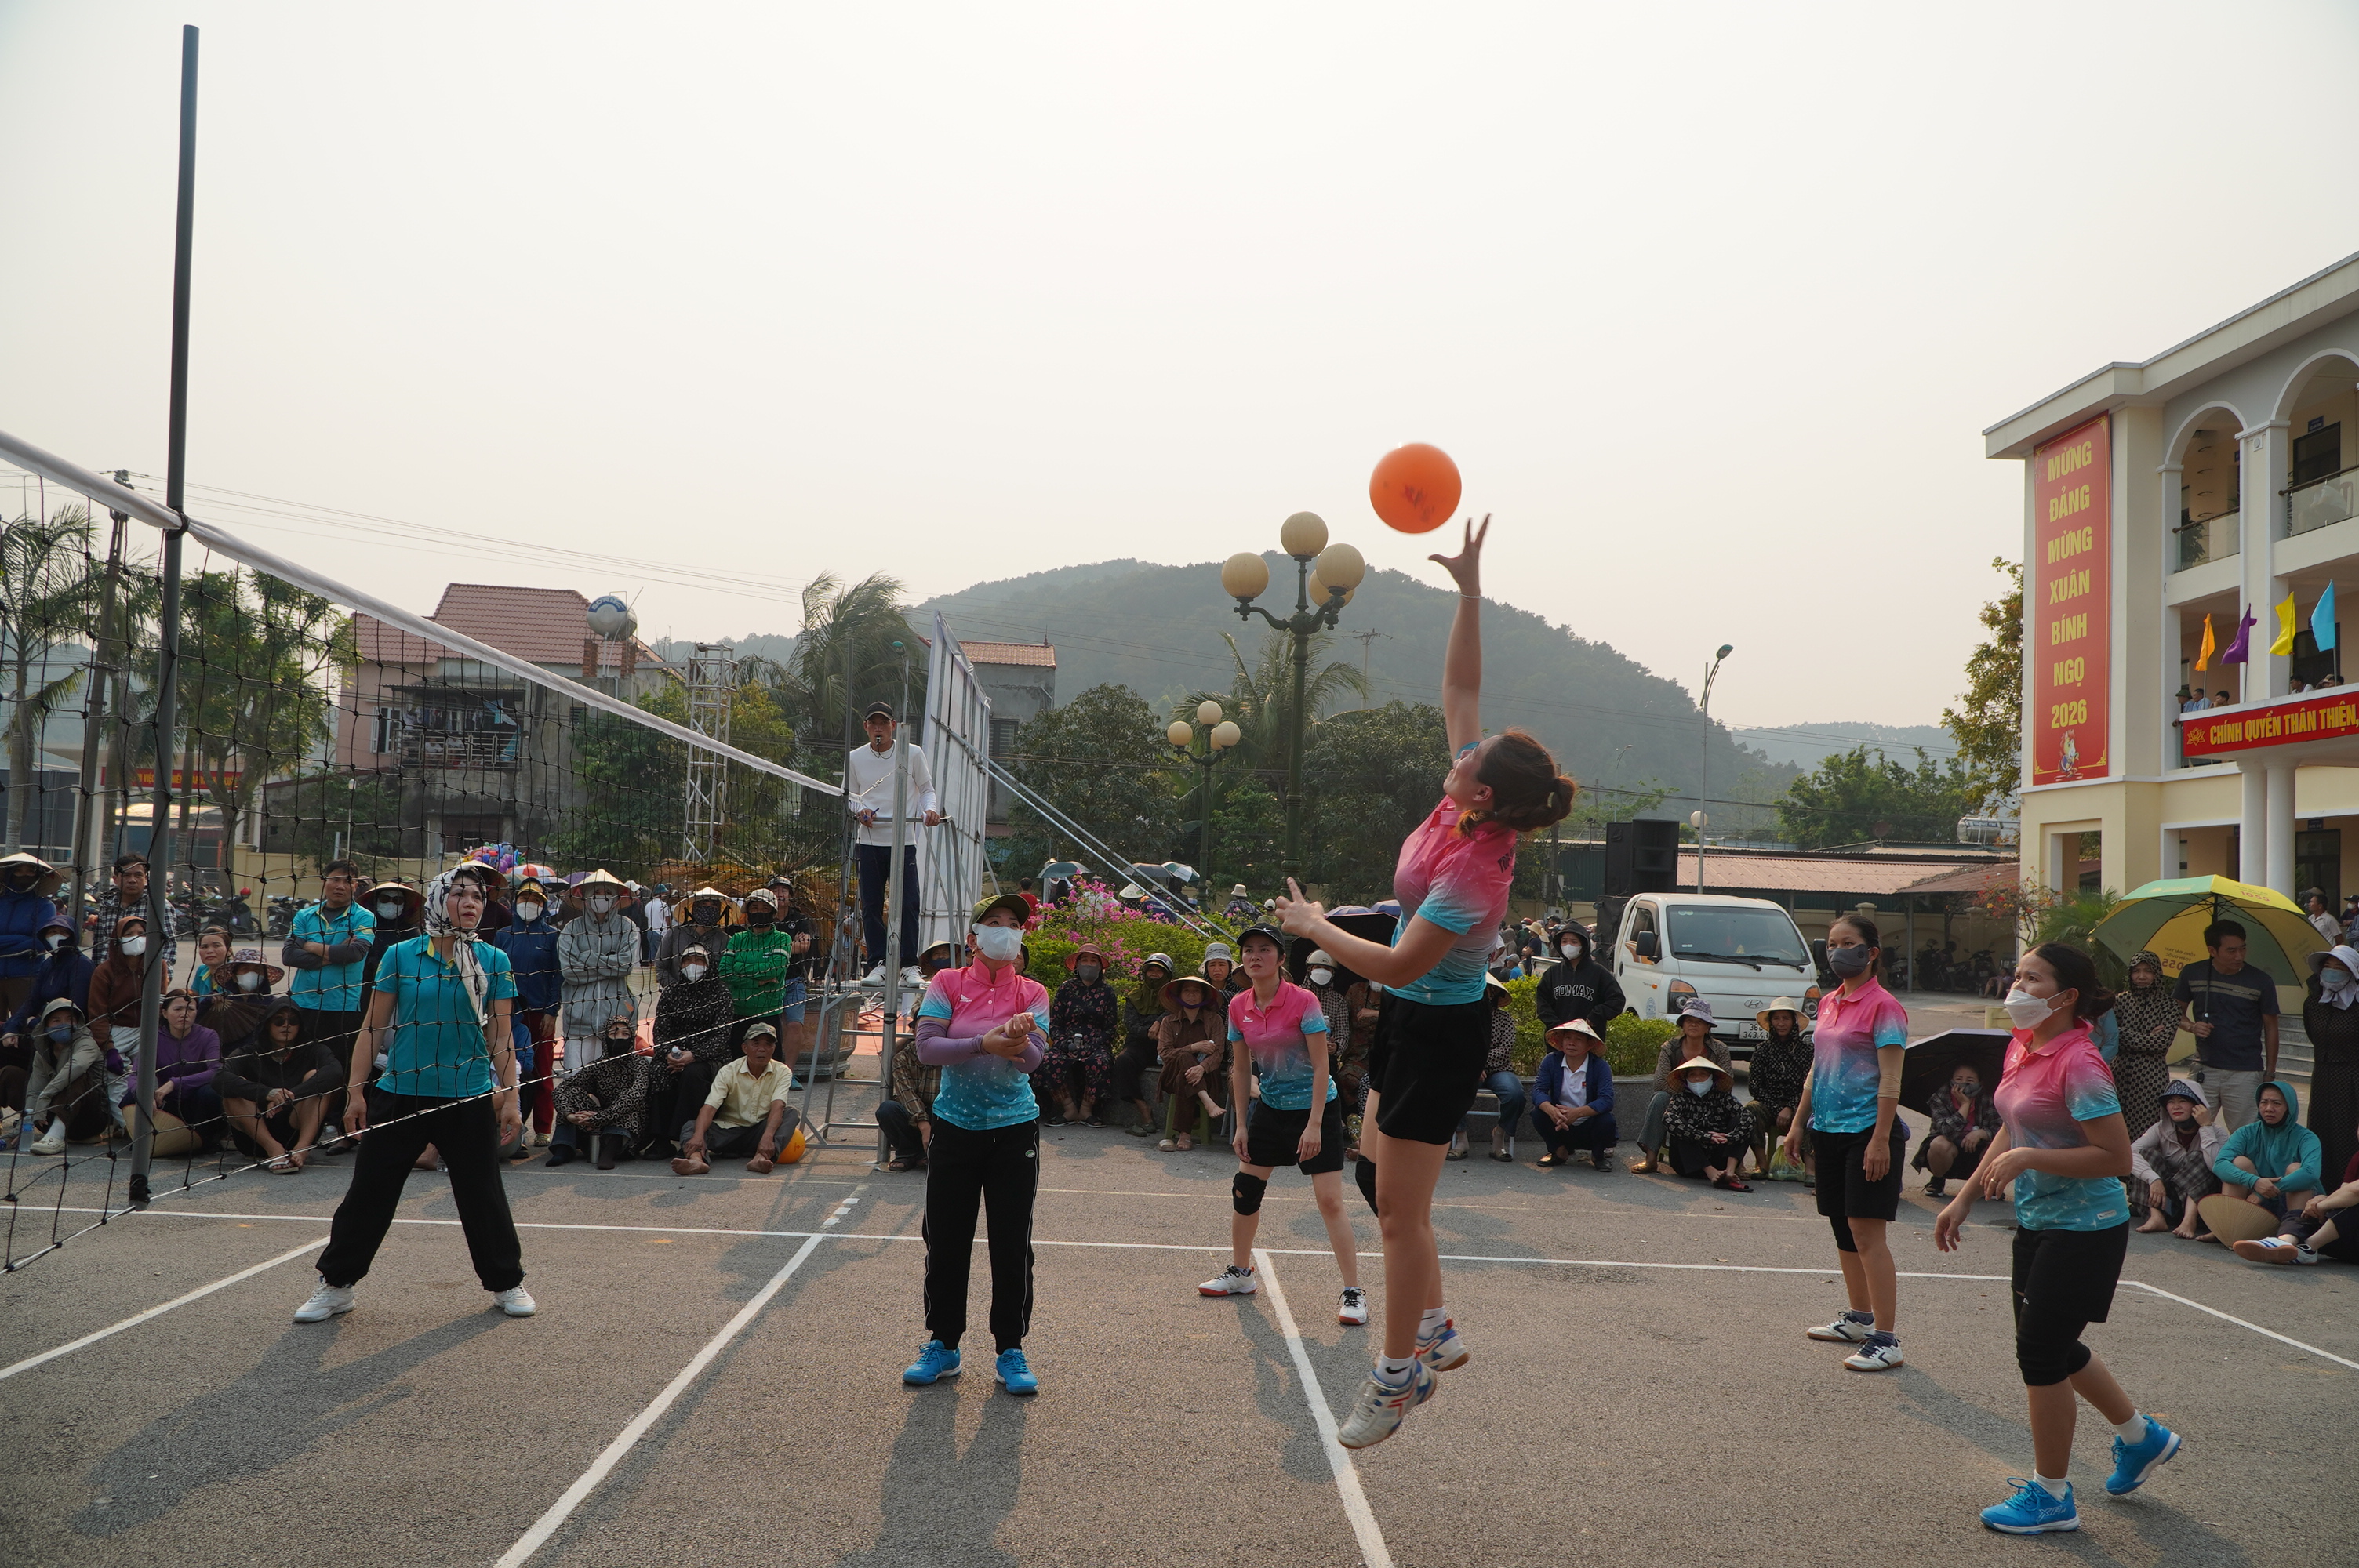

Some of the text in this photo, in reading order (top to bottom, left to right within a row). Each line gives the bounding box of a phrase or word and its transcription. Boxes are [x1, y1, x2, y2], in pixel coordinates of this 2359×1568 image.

[2048, 441, 2092, 483] MỪNG
[2049, 485, 2090, 523] ĐẢNG
[2048, 526, 2092, 564] MỪNG
[2049, 568, 2090, 605] XUÂN
[2052, 612, 2087, 646] BÍNH
[2053, 656, 2085, 687] NGỌ
[2051, 699, 2087, 729] 2026
[2210, 700, 2359, 746] CHÍNH QUYỀN THÂN THIỆN,
[2240, 891, 2270, 902] 1055
[1554, 984, 1594, 1001] FOMAX
